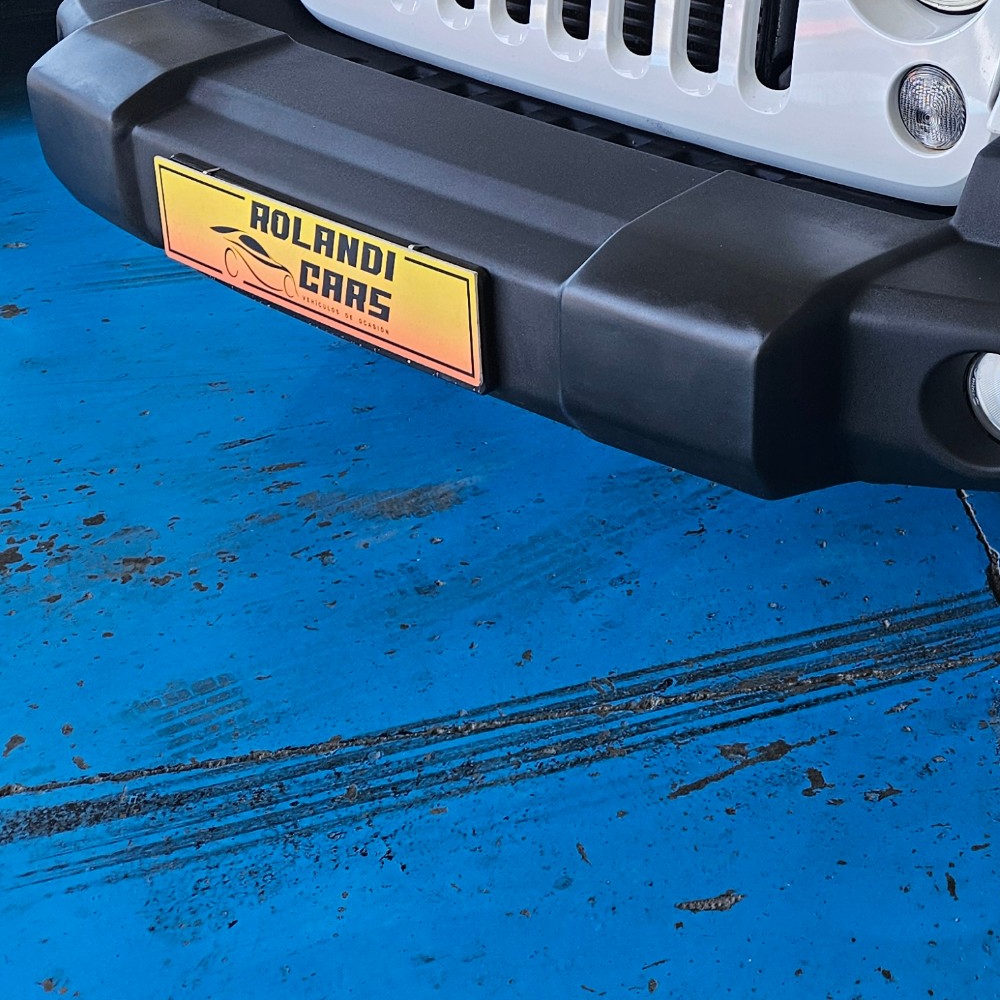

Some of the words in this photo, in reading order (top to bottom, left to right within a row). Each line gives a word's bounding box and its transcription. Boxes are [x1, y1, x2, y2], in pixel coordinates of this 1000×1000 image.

[250, 200, 396, 282] ROLANDI
[299, 259, 392, 322] CARS
[345, 312, 353, 321] DE
